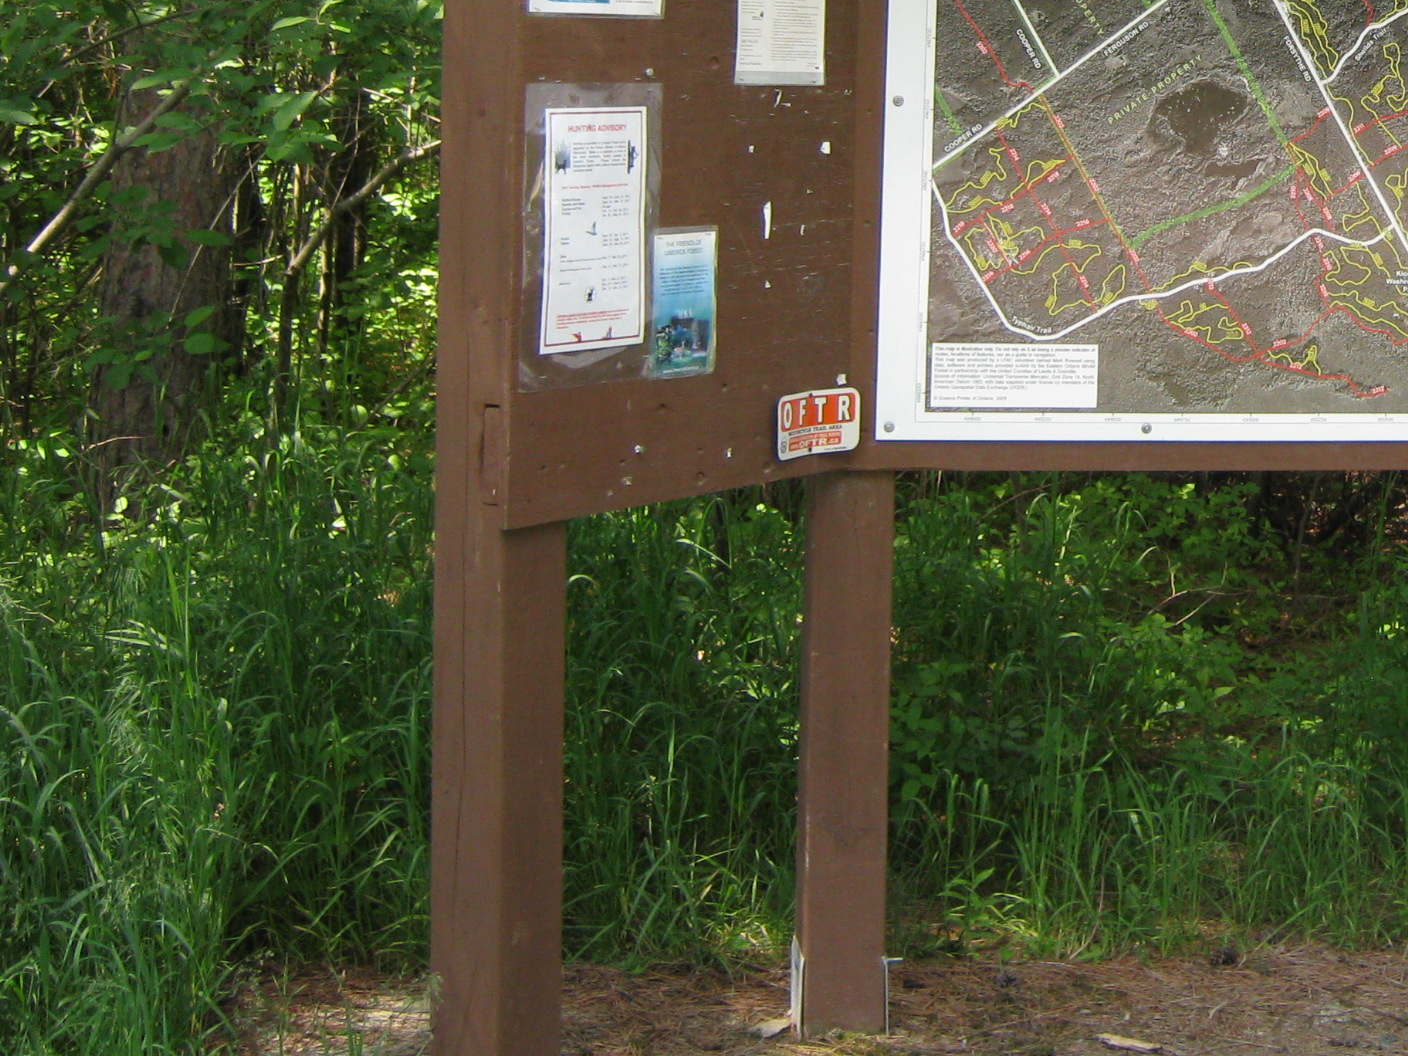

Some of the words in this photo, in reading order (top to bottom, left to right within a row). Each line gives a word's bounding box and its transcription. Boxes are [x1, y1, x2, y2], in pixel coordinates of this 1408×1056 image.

[1016, 29, 1036, 58] COOPER
[1103, 28, 1139, 56] FERGUSON
[1284, 35, 1306, 72] FORSYTHE
[1107, 93, 1149, 124] PRIVATE
[1151, 55, 1202, 94] PROPERTY
[598, 124, 627, 132] ADVISORY
[944, 130, 971, 153] COOPER
[784, 395, 850, 428] OFTR
